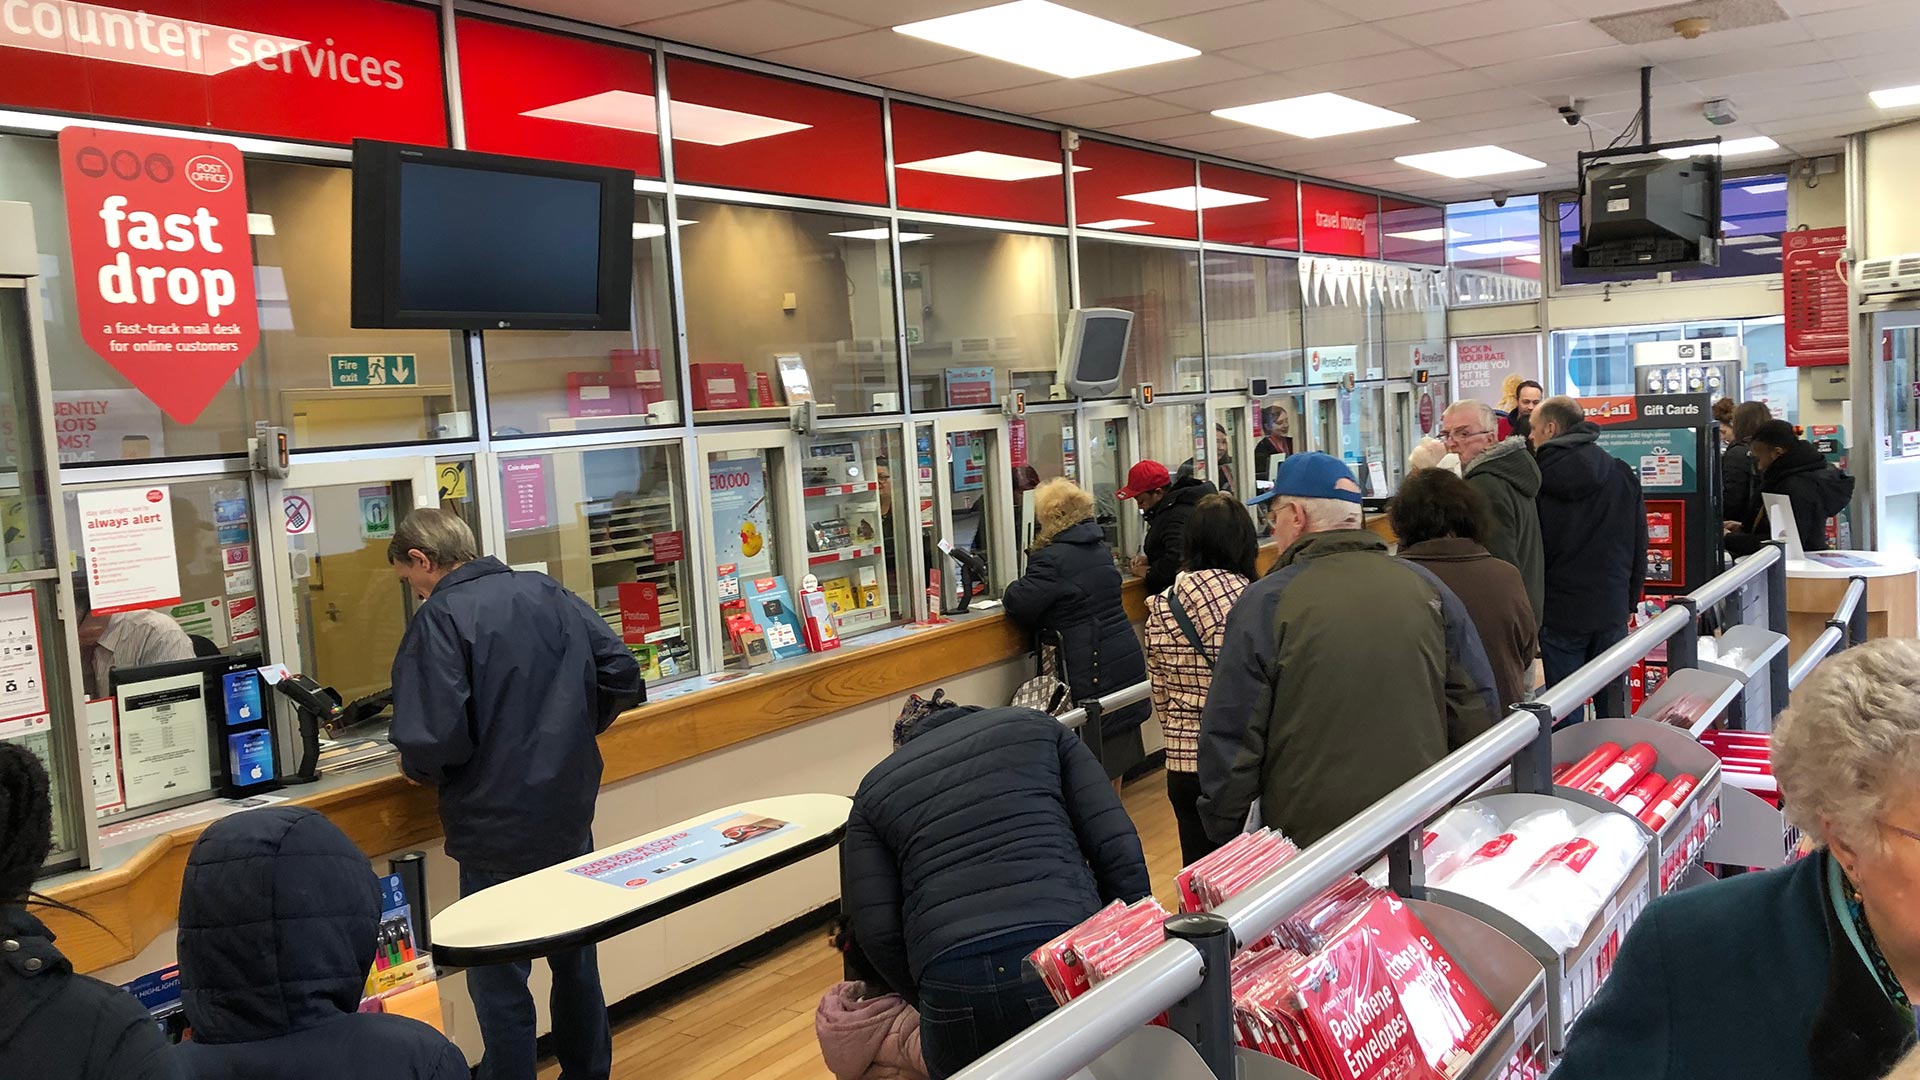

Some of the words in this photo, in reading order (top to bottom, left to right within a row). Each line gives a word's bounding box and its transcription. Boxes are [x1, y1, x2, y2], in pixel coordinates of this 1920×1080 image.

[4, 0, 211, 61] counter
[227, 33, 404, 90] services
[196, 163, 222, 173] POST
[191, 172, 227, 183] OFFICE
[99, 195, 224, 253] fast
[1315, 209, 1340, 229] travel
[1340, 216, 1366, 236] money
[98, 252, 236, 317] drop
[103, 324, 112, 334] a
[115, 322, 180, 335] fast-track
[183, 323, 210, 335] mail
[213, 323, 241, 335] desk
[110, 340, 129, 352] for
[133, 340, 173, 352] online
[176, 341, 239, 352] customers
[1458, 345, 1481, 354] LOCK
[1483, 344, 1492, 352] IN
[1322, 356, 1352, 369] MoneyGram
[1460, 354, 1483, 363] YOUR
[1484, 352, 1505, 361] RATE
[338, 360, 358, 370] Fire
[1460, 362, 1489, 371] BEFORE
[1491, 360, 1510, 369] YOU
[339, 372, 358, 383] exit
[1460, 371, 1474, 380] HIT
[1475, 370, 1490, 379] THE
[1460, 379, 1490, 388] SLOPES
[1144, 385, 1152, 404] 4
[1017, 393, 1025, 413] 5
[1644, 404, 1664, 416] Gift
[1666, 404, 1699, 415] Cards
[507, 464, 520, 472] Coin
[87, 518, 129, 530] always
[133, 513, 162, 526] alert
[624, 610, 650, 621] Position
[574, 859, 609, 873] OVER
[628, 844, 650, 858] LIFE
[650, 832, 692, 847] COVER
[583, 862, 622, 877] FROM
[652, 843, 678, 855] DAY
[1328, 984, 1394, 1049] Polythene
[1343, 1013, 1408, 1080] Envelopes
